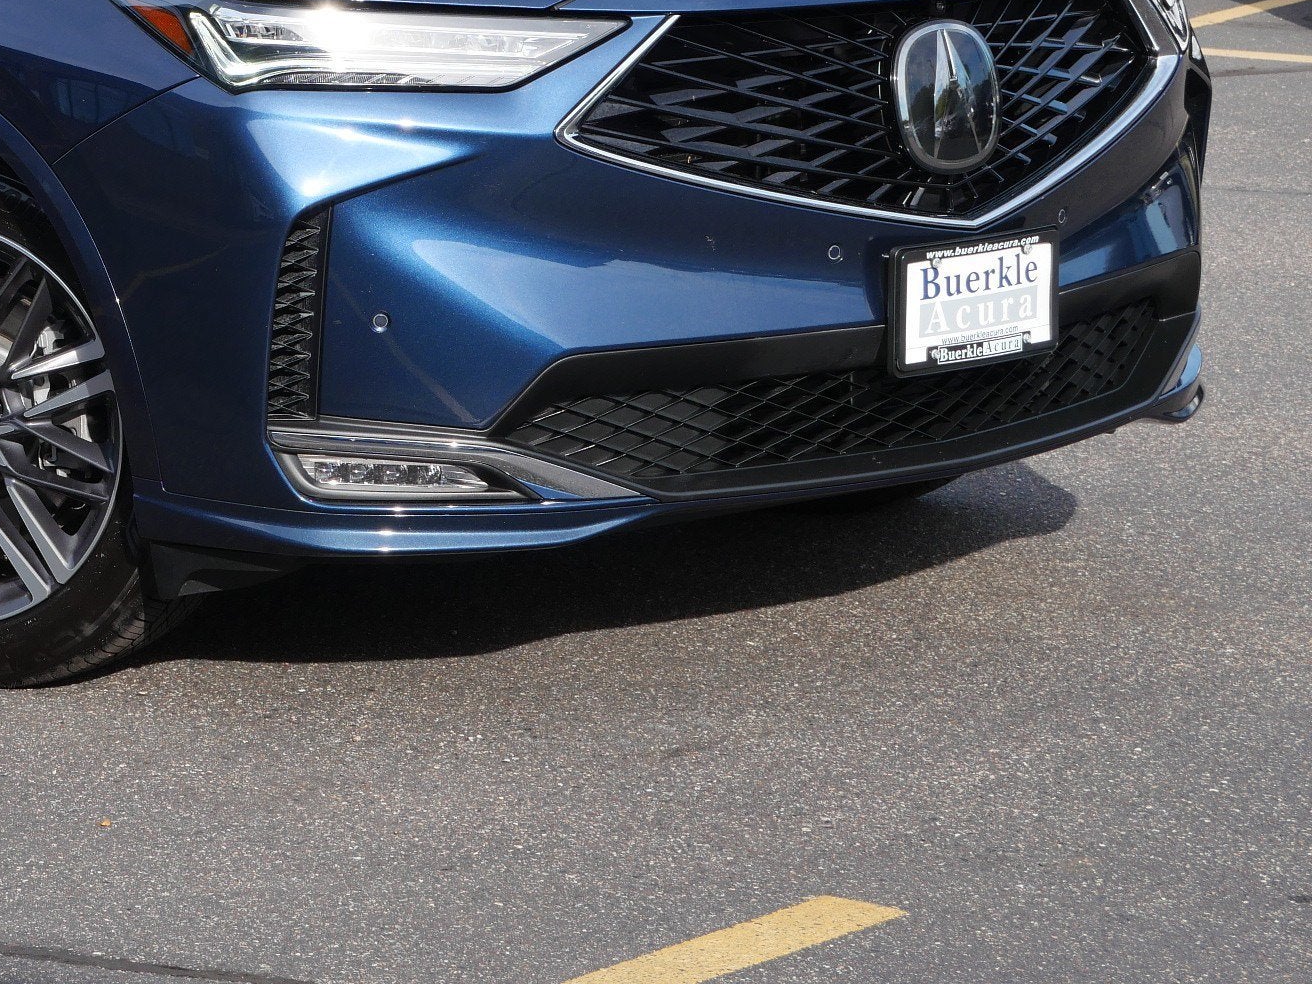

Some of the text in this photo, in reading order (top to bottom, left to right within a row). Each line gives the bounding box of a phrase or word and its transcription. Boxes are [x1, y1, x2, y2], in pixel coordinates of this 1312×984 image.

[926, 235, 1039, 259] www.buerkleacura.com
[920, 253, 1038, 301] Buerkle
[924, 294, 1033, 335] Acura
[941, 324, 1019, 345] www.buerkleacura.com
